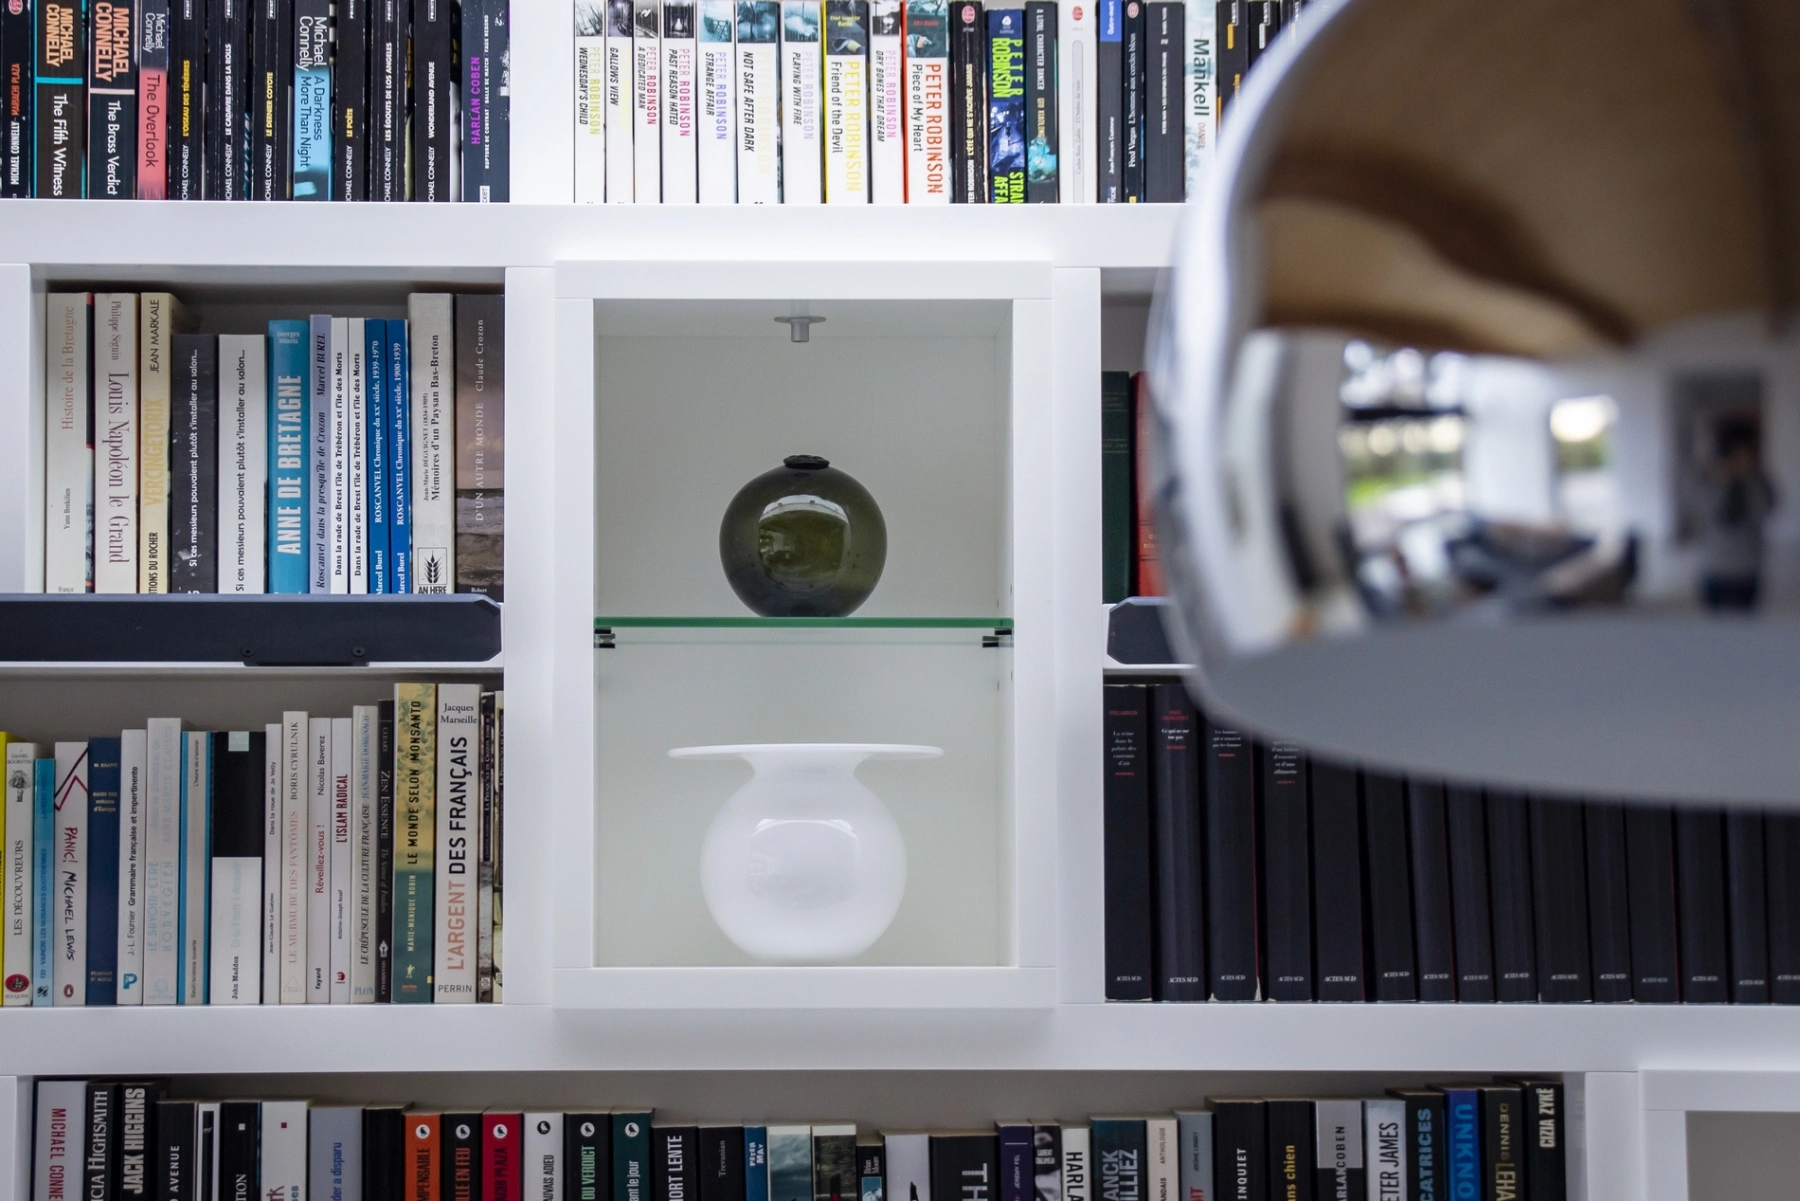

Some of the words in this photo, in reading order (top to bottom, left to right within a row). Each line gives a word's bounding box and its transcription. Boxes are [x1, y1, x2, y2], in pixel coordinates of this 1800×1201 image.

[47, 4, 60, 67] CONNELLY
[60, 8, 73, 63] MICHAEL
[96, 3, 113, 82] CONNELLY
[113, 8, 129, 77] MICHAEL
[143, 12, 155, 52] Connelly
[156, 14, 165, 48] Michael
[296, 16, 312, 72] Connelly
[314, 17, 327, 66] Michael
[471, 57, 480, 94] COBEN
[580, 47, 588, 100] WEDNESDAY'S
[590, 47, 600, 74] PETER
[669, 49, 677, 68] PAST
[680, 49, 689, 76] PETER
[706, 52, 714, 86] STRANGE
[716, 52, 726, 79] PETER
[744, 52, 753, 68] NOT
[992, 38, 1010, 97] ROBINSON
[1009, 39, 1023, 95] PETER
[147, 74, 160, 100] The
[301, 77, 311, 104] More
[314, 76, 324, 84] A
[670, 70, 678, 99] REASON
[744, 72, 754, 94] SAFE
[831, 62, 842, 93] Friend
[845, 62, 860, 107] PETER
[912, 64, 923, 91] Piece
[926, 64, 942, 109] PETER
[1194, 39, 1210, 116] Mankell
[54, 94, 68, 116] The
[108, 101, 121, 121] The
[314, 88, 324, 140] Darkness
[580, 103, 588, 124] CHILD
[590, 79, 600, 135] ROBINSON
[670, 102, 678, 125] HATED
[680, 81, 690, 137] ROBINSON
[706, 89, 714, 115] AFFAIR
[716, 84, 727, 140] ROBINSON
[744, 96, 754, 123] AFTER
[832, 97, 842, 106] of
[832, 109, 842, 124] the
[911, 108, 922, 120] My
[913, 95, 923, 104] of
[53, 119, 68, 144] Fifth
[146, 105, 159, 167] Overlook
[301, 106, 311, 134] Than
[471, 99, 480, 144] HARLAN
[107, 124, 119, 153] Brass
[298, 138, 311, 167] Night
[744, 127, 754, 152] DARK
[832, 128, 843, 153] Devil
[845, 113, 861, 191] ROBINSON
[913, 125, 923, 151] Heart
[926, 115, 943, 193] ROBINSON
[53, 148, 67, 196] Witness
[107, 156, 121, 195] Verdict
[62, 306, 74, 354] Bretagne
[109, 301, 122, 332] Philippe
[150, 300, 159, 345] MARKALE
[109, 334, 124, 360] Séguin
[316, 334, 326, 363] BUREL
[476, 320, 484, 354] Crozon
[61, 358, 74, 366] la
[61, 371, 74, 383] de
[150, 349, 159, 372] JEAN
[431, 335, 440, 388] Bas-Breton
[475, 358, 484, 392] Claude
[108, 372, 129, 413] Louis
[238, 383, 245, 395] au
[316, 365, 326, 396] Marcel
[61, 388, 74, 429] Histoire
[236, 398, 245, 439] s'installer
[278, 376, 301, 468] BRETAGNE
[431, 391, 442, 425] Paysan
[476, 403, 484, 446] MONDE
[316, 412, 326, 443] Crozon
[431, 428, 440, 450] d'un
[102, 419, 129, 487] Napoléon
[236, 442, 246, 470] plutôt
[316, 446, 325, 456] de
[316, 459, 327, 504] presqu'île
[431, 454, 440, 501] Mémoires
[476, 450, 484, 488] AUTRE
[108, 495, 129, 507] le
[236, 473, 246, 520] pouvaient
[278, 477, 301, 498] DE
[316, 506, 325, 514] la
[476, 492, 484, 521] D'UN
[109, 516, 129, 563] Grand
[236, 523, 245, 565] messieurs
[278, 506, 301, 554] ANNE
[316, 517, 326, 538] dans
[237, 568, 245, 581] ces
[316, 543, 326, 588] Roscanvel
[441, 716, 477, 724] Marseille
[443, 703, 473, 713] Jacques
[290, 722, 298, 770] CYRULNIK
[410, 701, 421, 761] MONSANTO
[129, 767, 139, 814] impertinente
[290, 774, 298, 800] BORIS
[317, 768, 325, 795] Nicolas
[336, 774, 348, 809] RADICAL
[409, 769, 419, 803] SELON
[449, 738, 471, 830] FRANÇAIS
[129, 816, 137, 824] et
[336, 812, 347, 842] L'ISLAM
[408, 809, 418, 847] MONDE
[62, 827, 77, 863] PANIC!
[129, 826, 138, 861] française
[408, 853, 417, 864] LE
[448, 837, 466, 874] DES
[12, 841, 23, 915] DÉCOUVREURS
[315, 830, 325, 893] Réveillez-vous
[62, 871, 77, 924] MICHAEL
[129, 863, 137, 906] Grammaire
[14, 919, 22, 935] LES
[128, 911, 136, 938] Fournier
[447, 880, 465, 970] L'ARGENT
[65, 928, 74, 960] LEWIS
[315, 968, 323, 990] fayard
[438, 985, 472, 993] PERRIN
[1536, 1088, 1554, 1115] ZYKË
[50, 1108, 66, 1159] MICHAEL
[88, 1091, 107, 1170] HIGHSMITH
[124, 1088, 145, 1150] HIGGINS
[1539, 1120, 1555, 1147] CIZIA
[331, 1142, 344, 1175] disparu
[456, 1148, 470, 1165] FEU
[668, 1136, 682, 1171] LENTE
[718, 1140, 726, 1177] Trevanian
[756, 1144, 764, 1163] MAY
[1335, 1126, 1345, 1167] COBEN
[1379, 1123, 1399, 1167] JAMES
[123, 1154, 144, 1194] JACK
[170, 1145, 179, 1192] AVENUE
[456, 1169, 470, 1181] EN
[544, 1155, 554, 1175] ADIEU
[582, 1146, 595, 1184] VERDICT
[628, 1161, 640, 1177] jour
[1284, 1145, 1295, 1180] chien
[582, 1187, 595, 1199] DU
